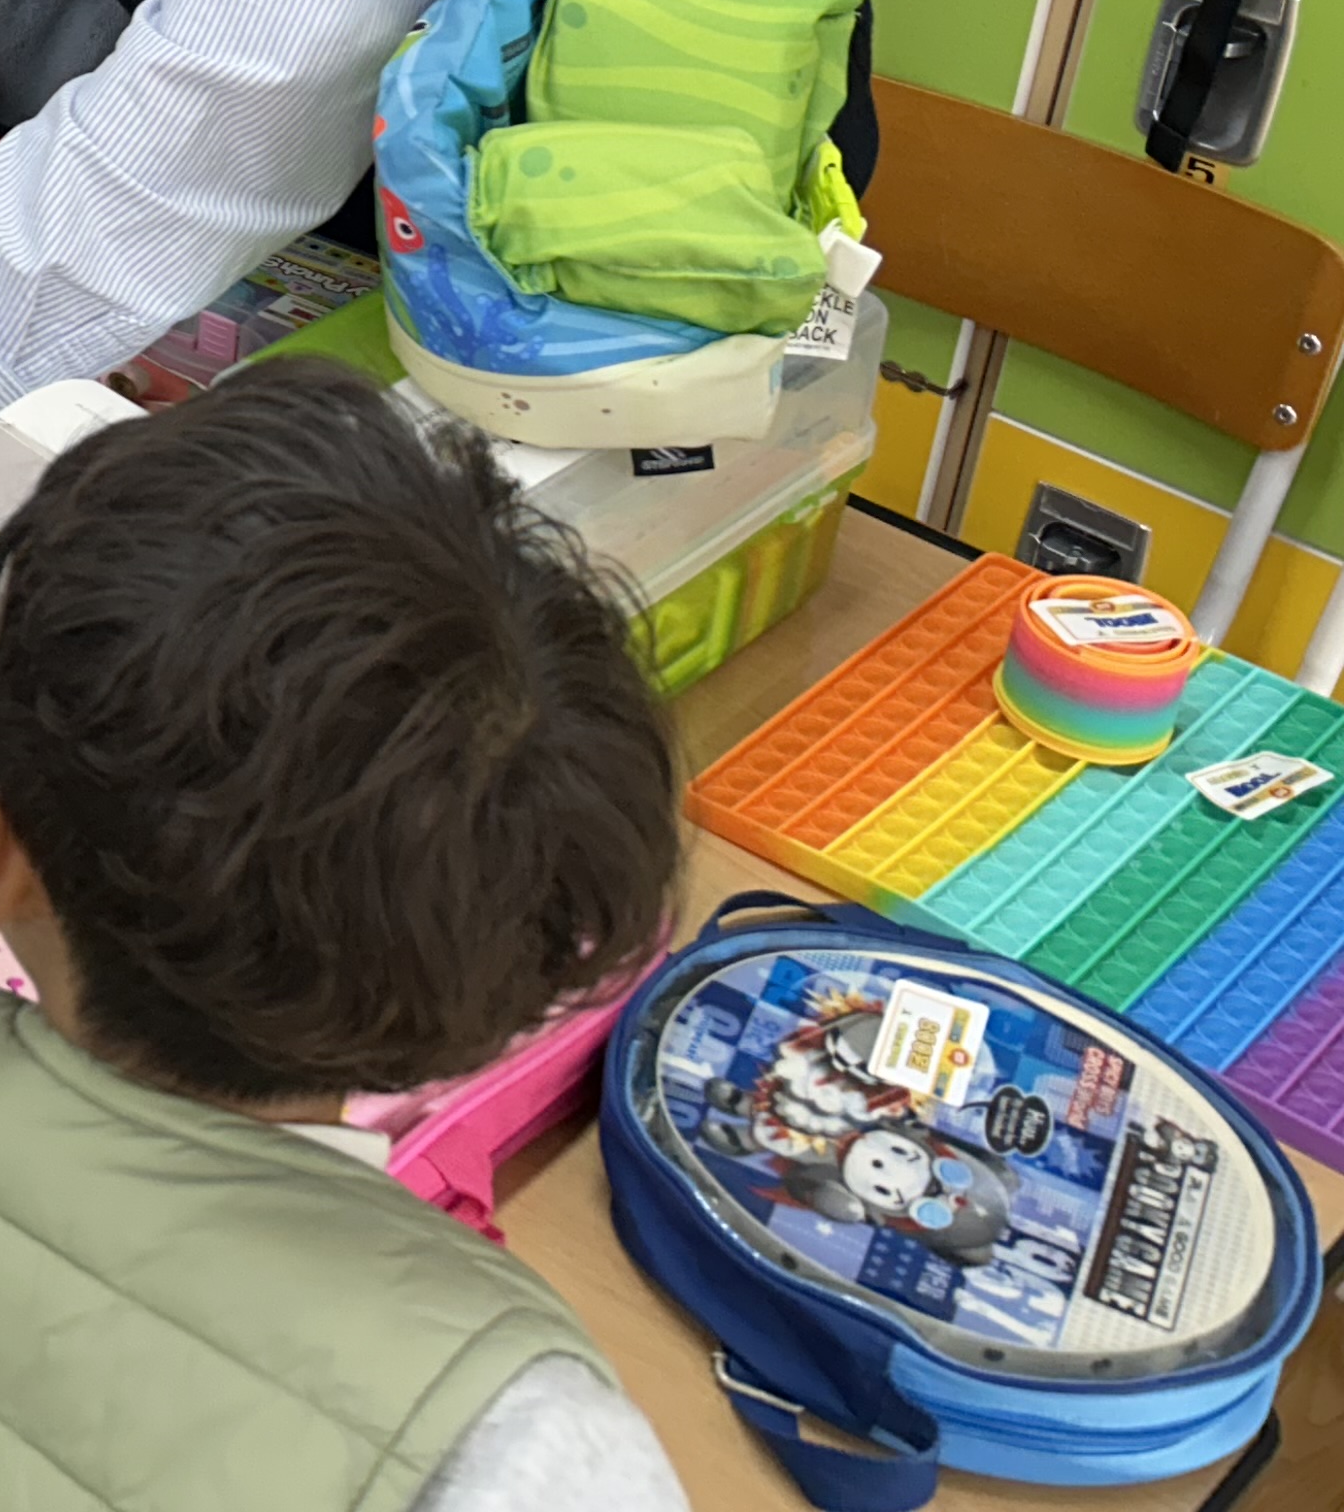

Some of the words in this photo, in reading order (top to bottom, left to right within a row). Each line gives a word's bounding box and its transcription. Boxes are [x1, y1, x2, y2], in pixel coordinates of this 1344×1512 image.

[1185, 160, 1216, 185] 5
[812, 291, 856, 316] KLE
[907, 1018, 940, 1074] 800원
